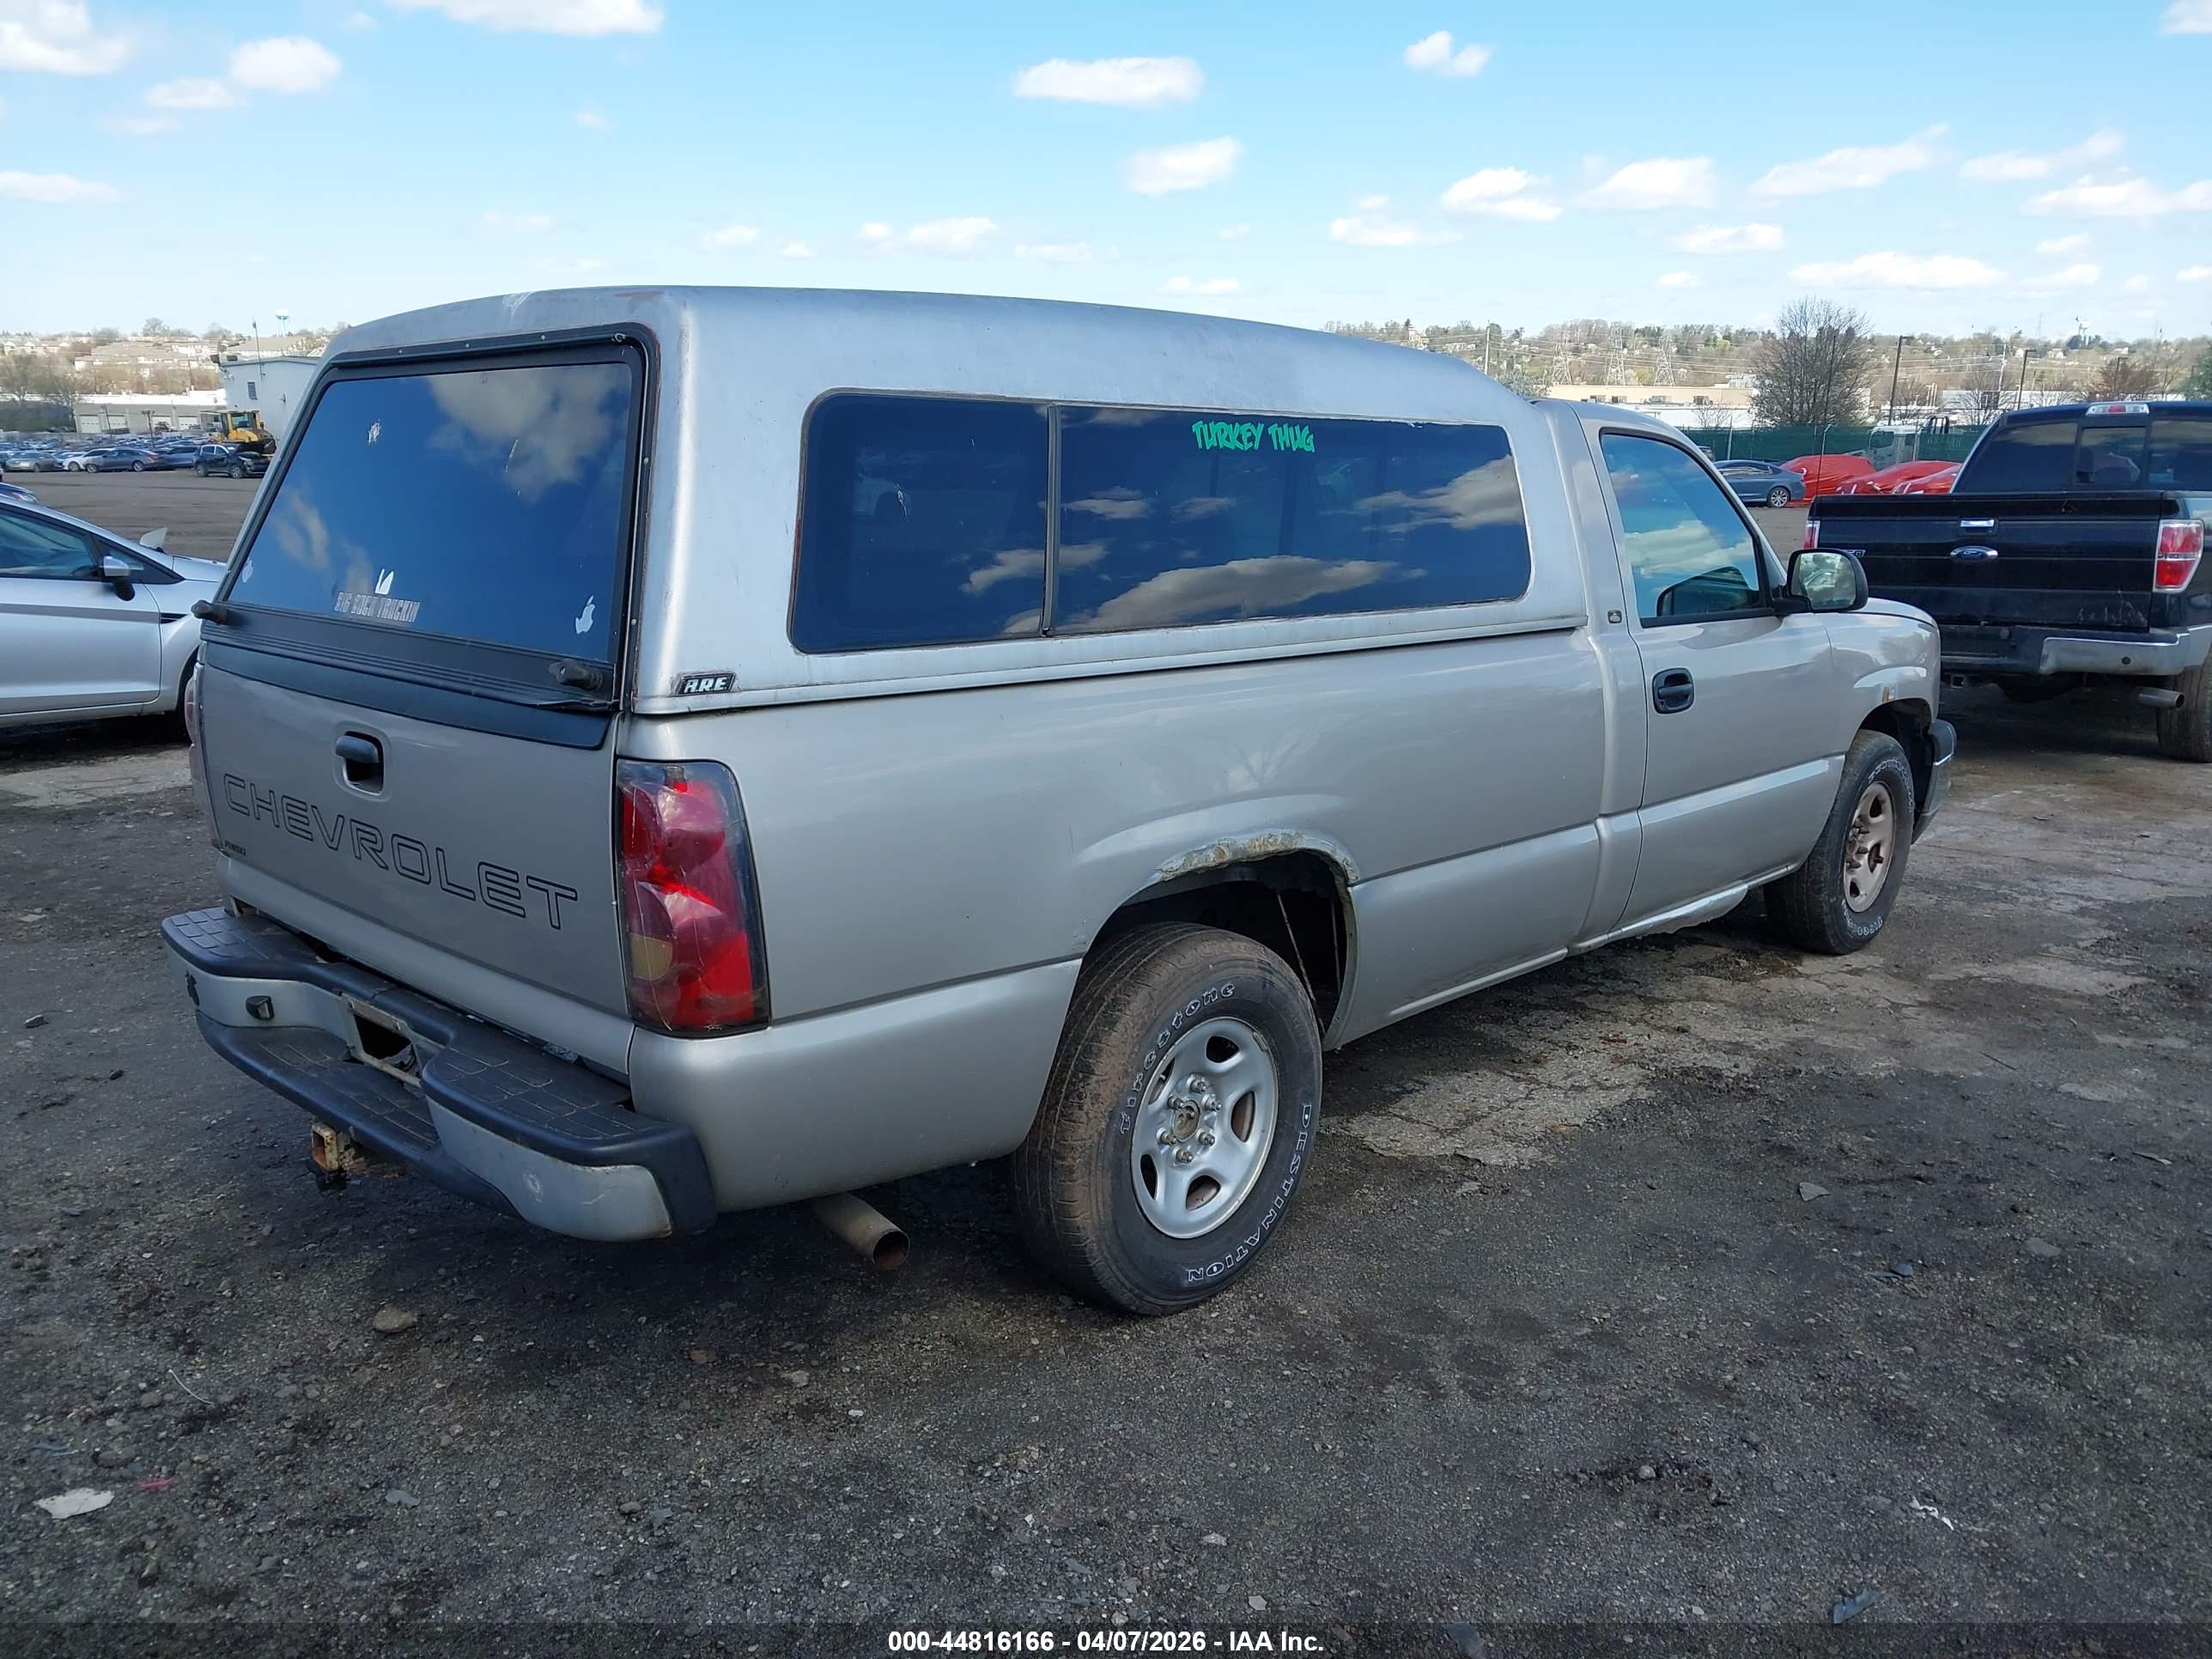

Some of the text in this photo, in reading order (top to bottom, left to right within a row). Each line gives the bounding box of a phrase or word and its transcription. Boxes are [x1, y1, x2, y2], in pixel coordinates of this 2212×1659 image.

[1191, 420, 1316, 453] TURKEY THUG
[223, 773, 579, 930] CHEVROLET
[1188, 1104, 1312, 1282] DESTINATION
